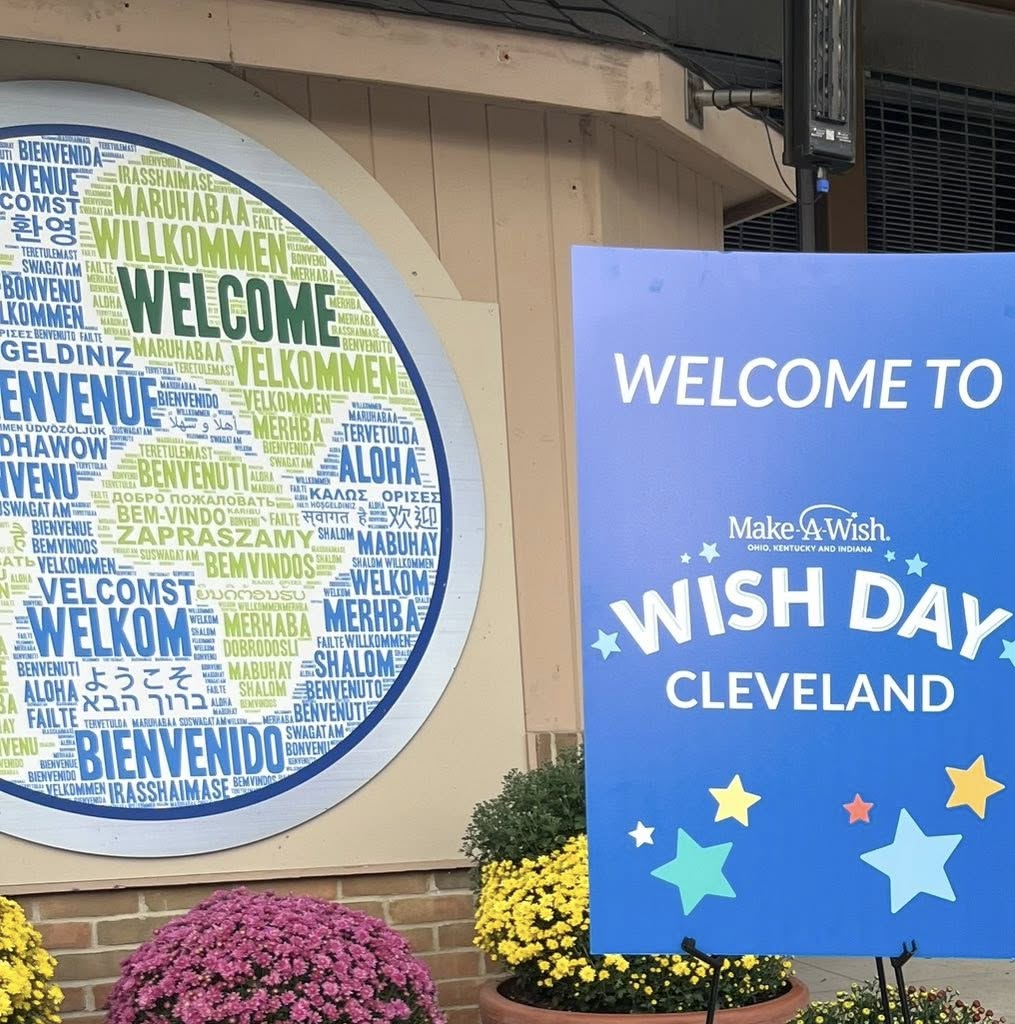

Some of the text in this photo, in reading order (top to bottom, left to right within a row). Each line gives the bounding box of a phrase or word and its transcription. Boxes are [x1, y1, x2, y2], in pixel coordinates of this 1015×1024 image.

[18, 140, 103, 167] BIENVENIDA
[118, 165, 214, 192] IRASSHAIMASE
[0, 192, 80, 215] COMST
[113, 185, 250, 227] MARUHABAA
[11, 214, 77, 246] 환영
[253, 215, 284, 231] FAILTE
[22, 246, 78, 260] TERETULEMAST
[90, 217, 288, 274] WILLKOMMEN
[22, 259, 82, 277] SWAGATAM
[86, 260, 114, 274] FAILTE
[290, 266, 336, 285] MERHABA
[2, 274, 82, 304] BONVENU
[116, 266, 340, 348] WELCOME
[34, 329, 76, 341] BENVENUTO
[80, 332, 102, 344] FAILTE
[0, 340, 134, 368] GELDINIZ
[132, 336, 224, 362] MARUHABAA
[342, 338, 393, 354] BENVENUTO
[174, 362, 235, 376] TERETULEMAST
[231, 344, 398, 396] VELKOMMEN
[613, 352, 1004, 410] WELCOME TO
[157, 390, 219, 410] BIENVENIDO
[242, 389, 332, 415] VELKOMMEN
[348, 410, 398, 424] MARUHABAA
[252, 414, 324, 442] MERHBA
[342, 423, 419, 446] TERVETULOA
[139, 444, 213, 460] TERETULEMAST
[262, 440, 316, 456] BIENVENIDA
[270, 456, 314, 468] SWAGATAM
[340, 444, 422, 485] ALOHA
[136, 458, 250, 492] BENVENUTI
[250, 471, 274, 482] ALOHA
[112, 492, 276, 508] ДОБРО ПОЖАЛОВАТЬ
[117, 505, 226, 525] BEM-VINDO
[270, 512, 300, 526] FAILTE
[388, 505, 438, 530] 欢迎
[32, 520, 94, 537] BIENVENUE
[116, 526, 314, 548] ZAPRASZAMY
[318, 528, 355, 541] SHALOM
[32, 538, 98, 555] BEMVINDOS
[357, 530, 438, 556] MABUHAY
[747, 544, 772, 553] OHIO,
[773, 544, 817, 553] KENTUCKY
[818, 545, 836, 553] AND
[140, 548, 200, 562] SUSWAGATAM
[352, 557, 434, 569] SHALOM WILLKOMMEN
[38, 556, 118, 576] VELKOMMEN
[204, 552, 316, 579] BEMVINDOS
[38, 576, 196, 606] VELCOMST
[350, 568, 430, 596] WELKOM
[324, 588, 351, 598] WELKOM
[189, 614, 219, 624] WELKOM
[323, 598, 421, 633] MERHBA
[608, 566, 1014, 661] WISH DAY
[26, 606, 192, 658] WELKOM
[223, 612, 312, 638] MERHABA
[223, 638, 299, 658] DOBRODOSLI
[317, 636, 345, 649] FAILTE
[344, 634, 412, 649] WILLKOMMEN
[16, 661, 80, 677] BENVENUTI
[228, 661, 292, 680] MABUHAY
[314, 650, 396, 678] SHALOM
[84, 666, 192, 691] ようこそ
[24, 679, 79, 703] ALOHA
[239, 682, 287, 698] SHALOM
[305, 680, 384, 700] BENVENUTO
[665, 669, 955, 713] CLEVELAND
[82, 693, 208, 716] ברוך הבא
[294, 702, 368, 723] BENVENUTI
[26, 708, 79, 729] FAILTE
[84, 718, 128, 729] TERVETULOA
[132, 718, 177, 728] MARUHABAA
[286, 724, 345, 740] SWAGATAM
[74, 725, 286, 781] BIENVENIDO
[285, 740, 331, 756] BONVENU
[40, 759, 78, 770] BIENVENUE
[28, 770, 76, 783] BIENVENIDO
[46, 782, 106, 797] VELKOMMEN
[108, 778, 230, 804] IRASSHAIMASE
